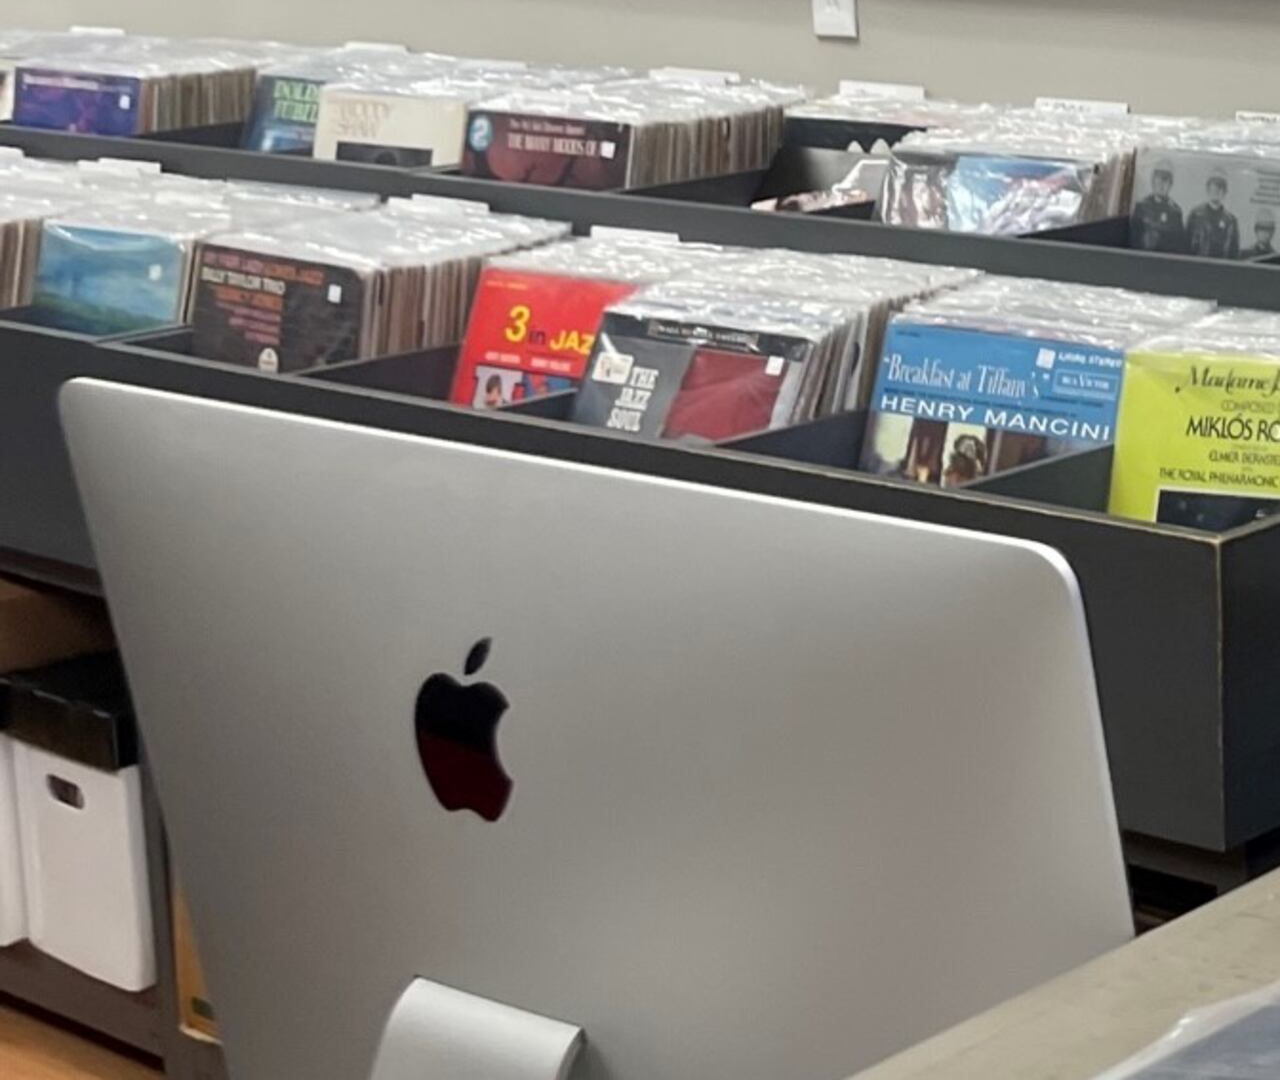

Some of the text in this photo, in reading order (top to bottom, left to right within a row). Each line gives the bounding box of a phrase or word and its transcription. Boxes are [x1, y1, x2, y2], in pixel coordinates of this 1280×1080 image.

[505, 305, 530, 342] 3
[549, 329, 595, 355] JAZ
[629, 366, 659, 390] THE
[956, 370, 971, 391] at
[1174, 365, 1266, 395] Madame
[615, 386, 652, 411] JAZZ
[606, 407, 642, 432] SOUL
[880, 395, 1110, 441] HENRY MANCINI
[1186, 412, 1254, 442] MIKLÓS
[1208, 449, 1240, 464] ELMER
[1159, 466, 1176, 480] THE
[1176, 468, 1207, 483] ROYAL
[1208, 471, 1279, 488] PHILHARMONIC
